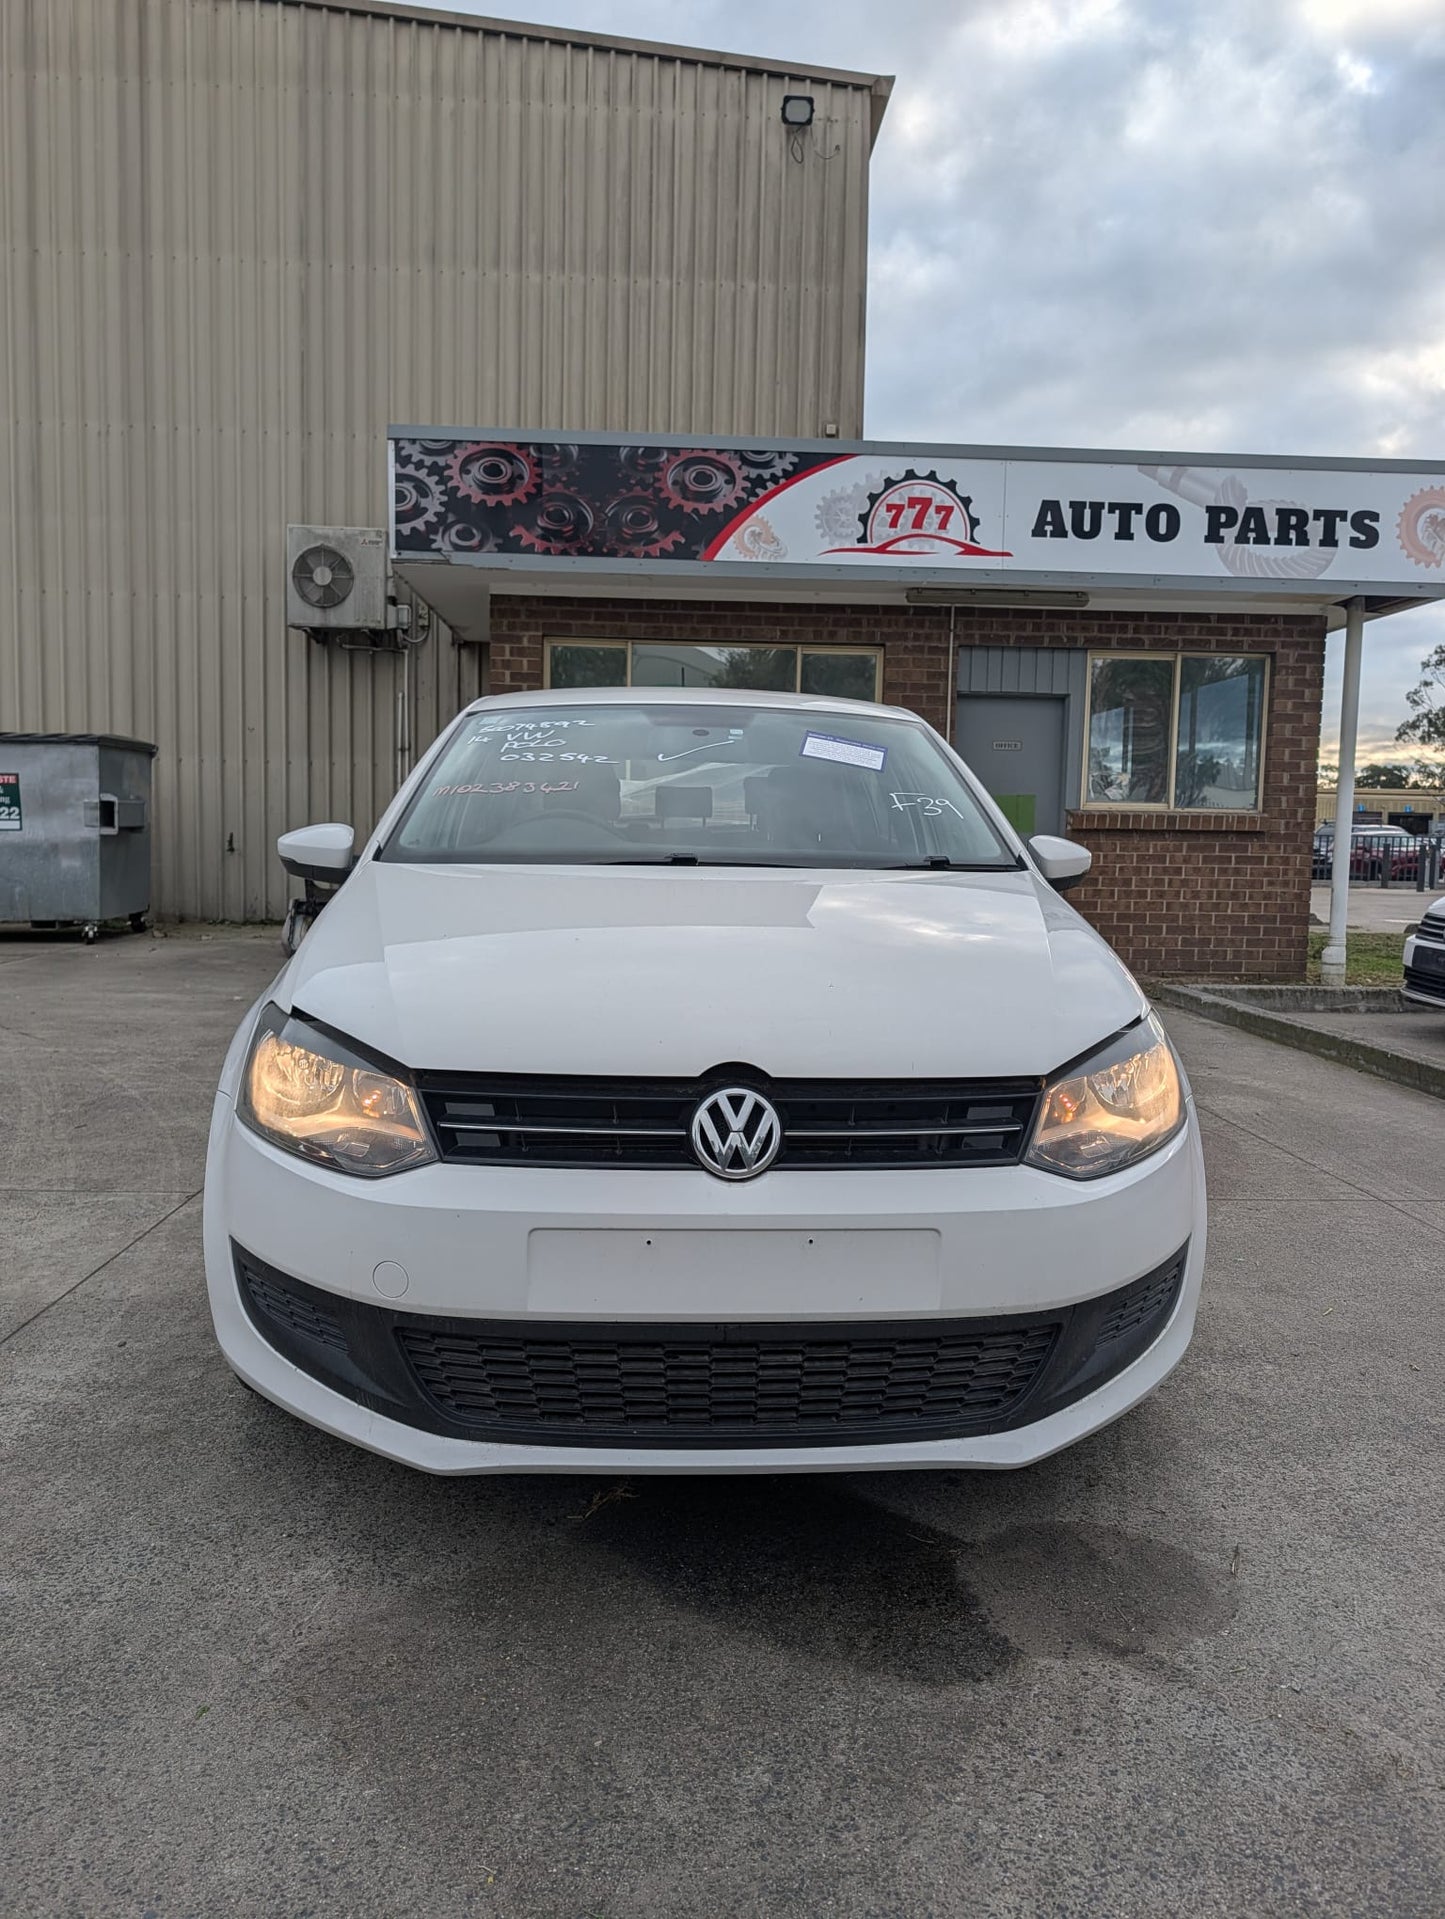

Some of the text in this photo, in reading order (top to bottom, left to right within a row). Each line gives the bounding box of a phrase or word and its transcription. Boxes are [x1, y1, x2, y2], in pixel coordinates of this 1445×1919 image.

[885, 496, 955, 531] 777
[1031, 499, 1380, 549] AUTO PARTS
[507, 730, 555, 741] VW
[500, 739, 567, 753] POLO
[994, 742, 1020, 750] OFFICE
[500, 752, 620, 765] 032542
[889, 792, 964, 819] F39
[695, 1090, 777, 1174] VW
